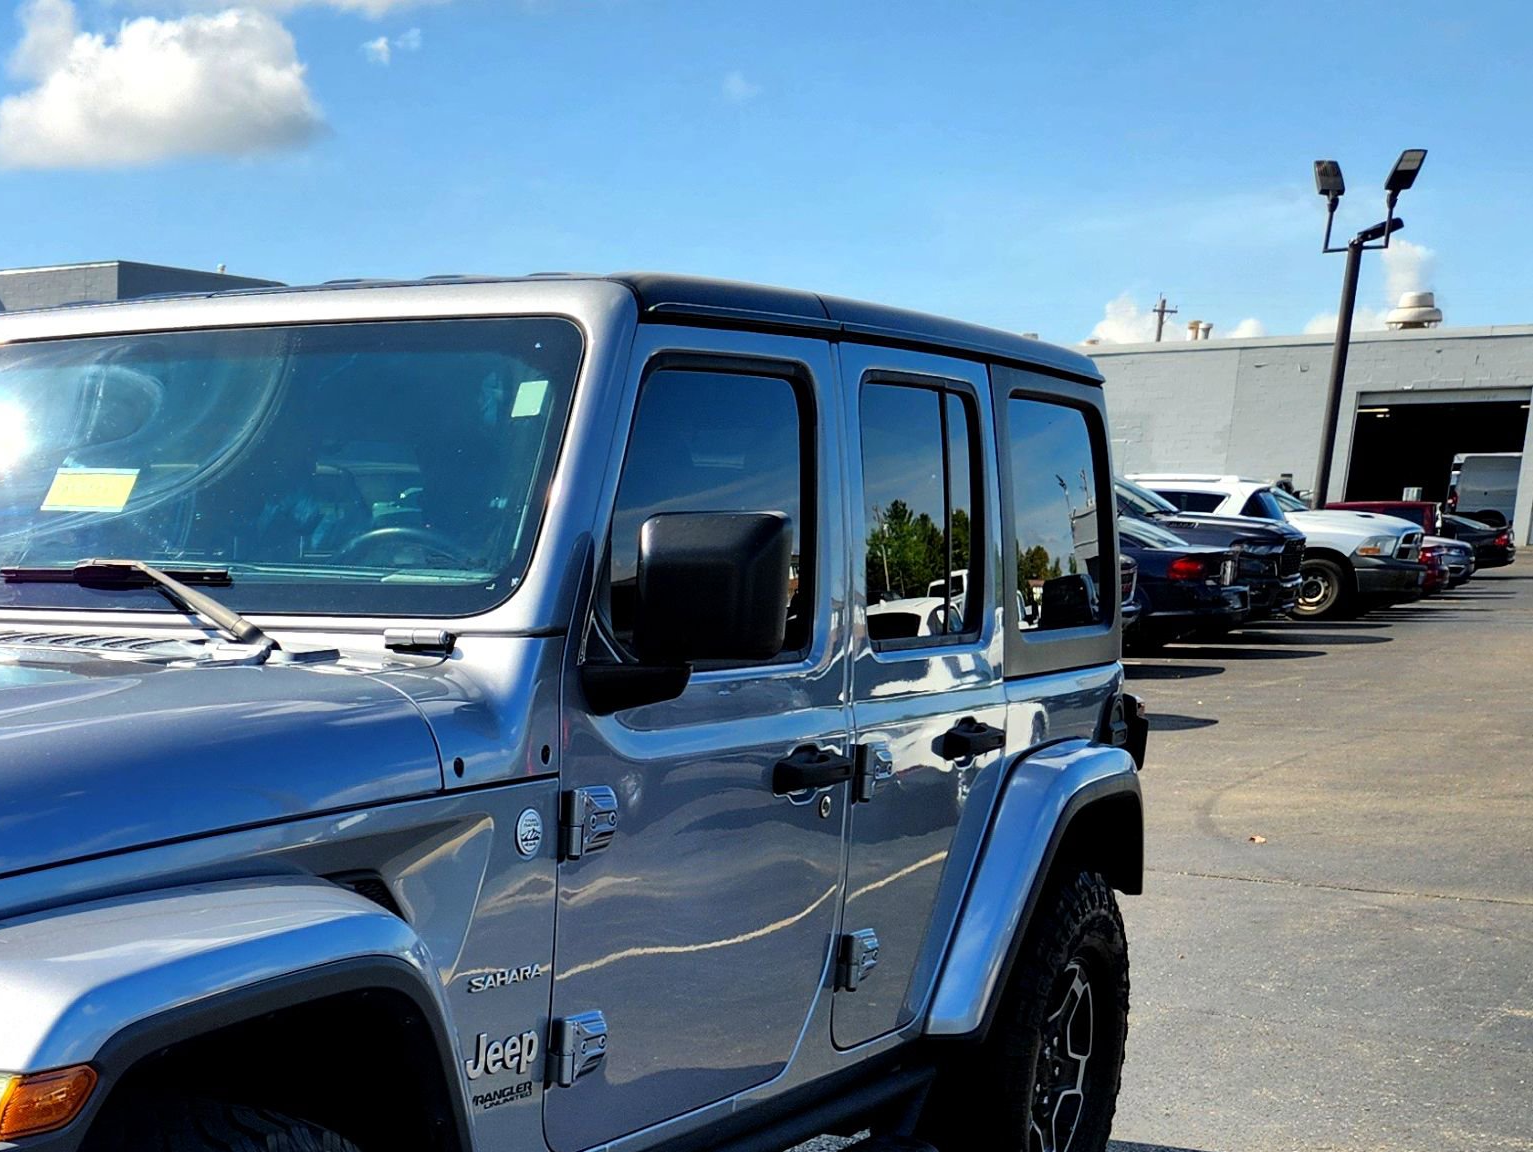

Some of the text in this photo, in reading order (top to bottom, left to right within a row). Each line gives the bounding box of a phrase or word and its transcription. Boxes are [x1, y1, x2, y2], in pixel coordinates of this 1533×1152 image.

[469, 963, 542, 992] SAHARA
[465, 1030, 539, 1079] Jeep
[483, 1091, 532, 1110] UNLIMITED
